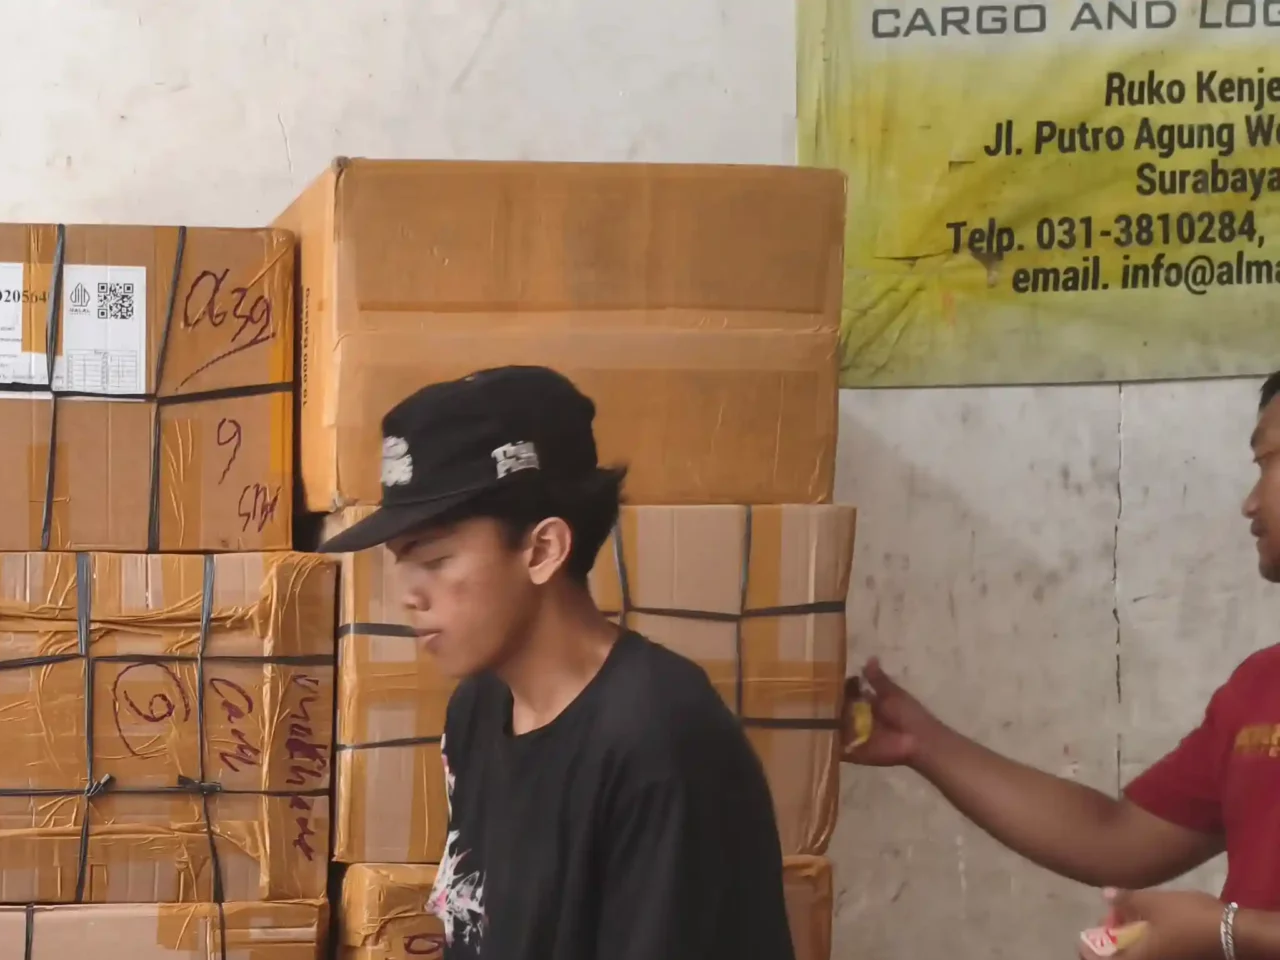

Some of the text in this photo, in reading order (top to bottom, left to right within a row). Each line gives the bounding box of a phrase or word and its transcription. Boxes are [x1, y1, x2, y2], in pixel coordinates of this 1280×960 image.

[872, 5, 1048, 38] CARGO
[1070, 0, 1177, 31] AND
[1105, 67, 1280, 112] Ruko Kenje
[984, 120, 1023, 156] Jl.
[1035, 120, 1125, 155] Putro
[1134, 117, 1235, 159] Agung
[1136, 158, 1280, 201] Surabaya
[946, 211, 1265, 258] Telp. 031-3810284,
[1012, 257, 1109, 293] email.
